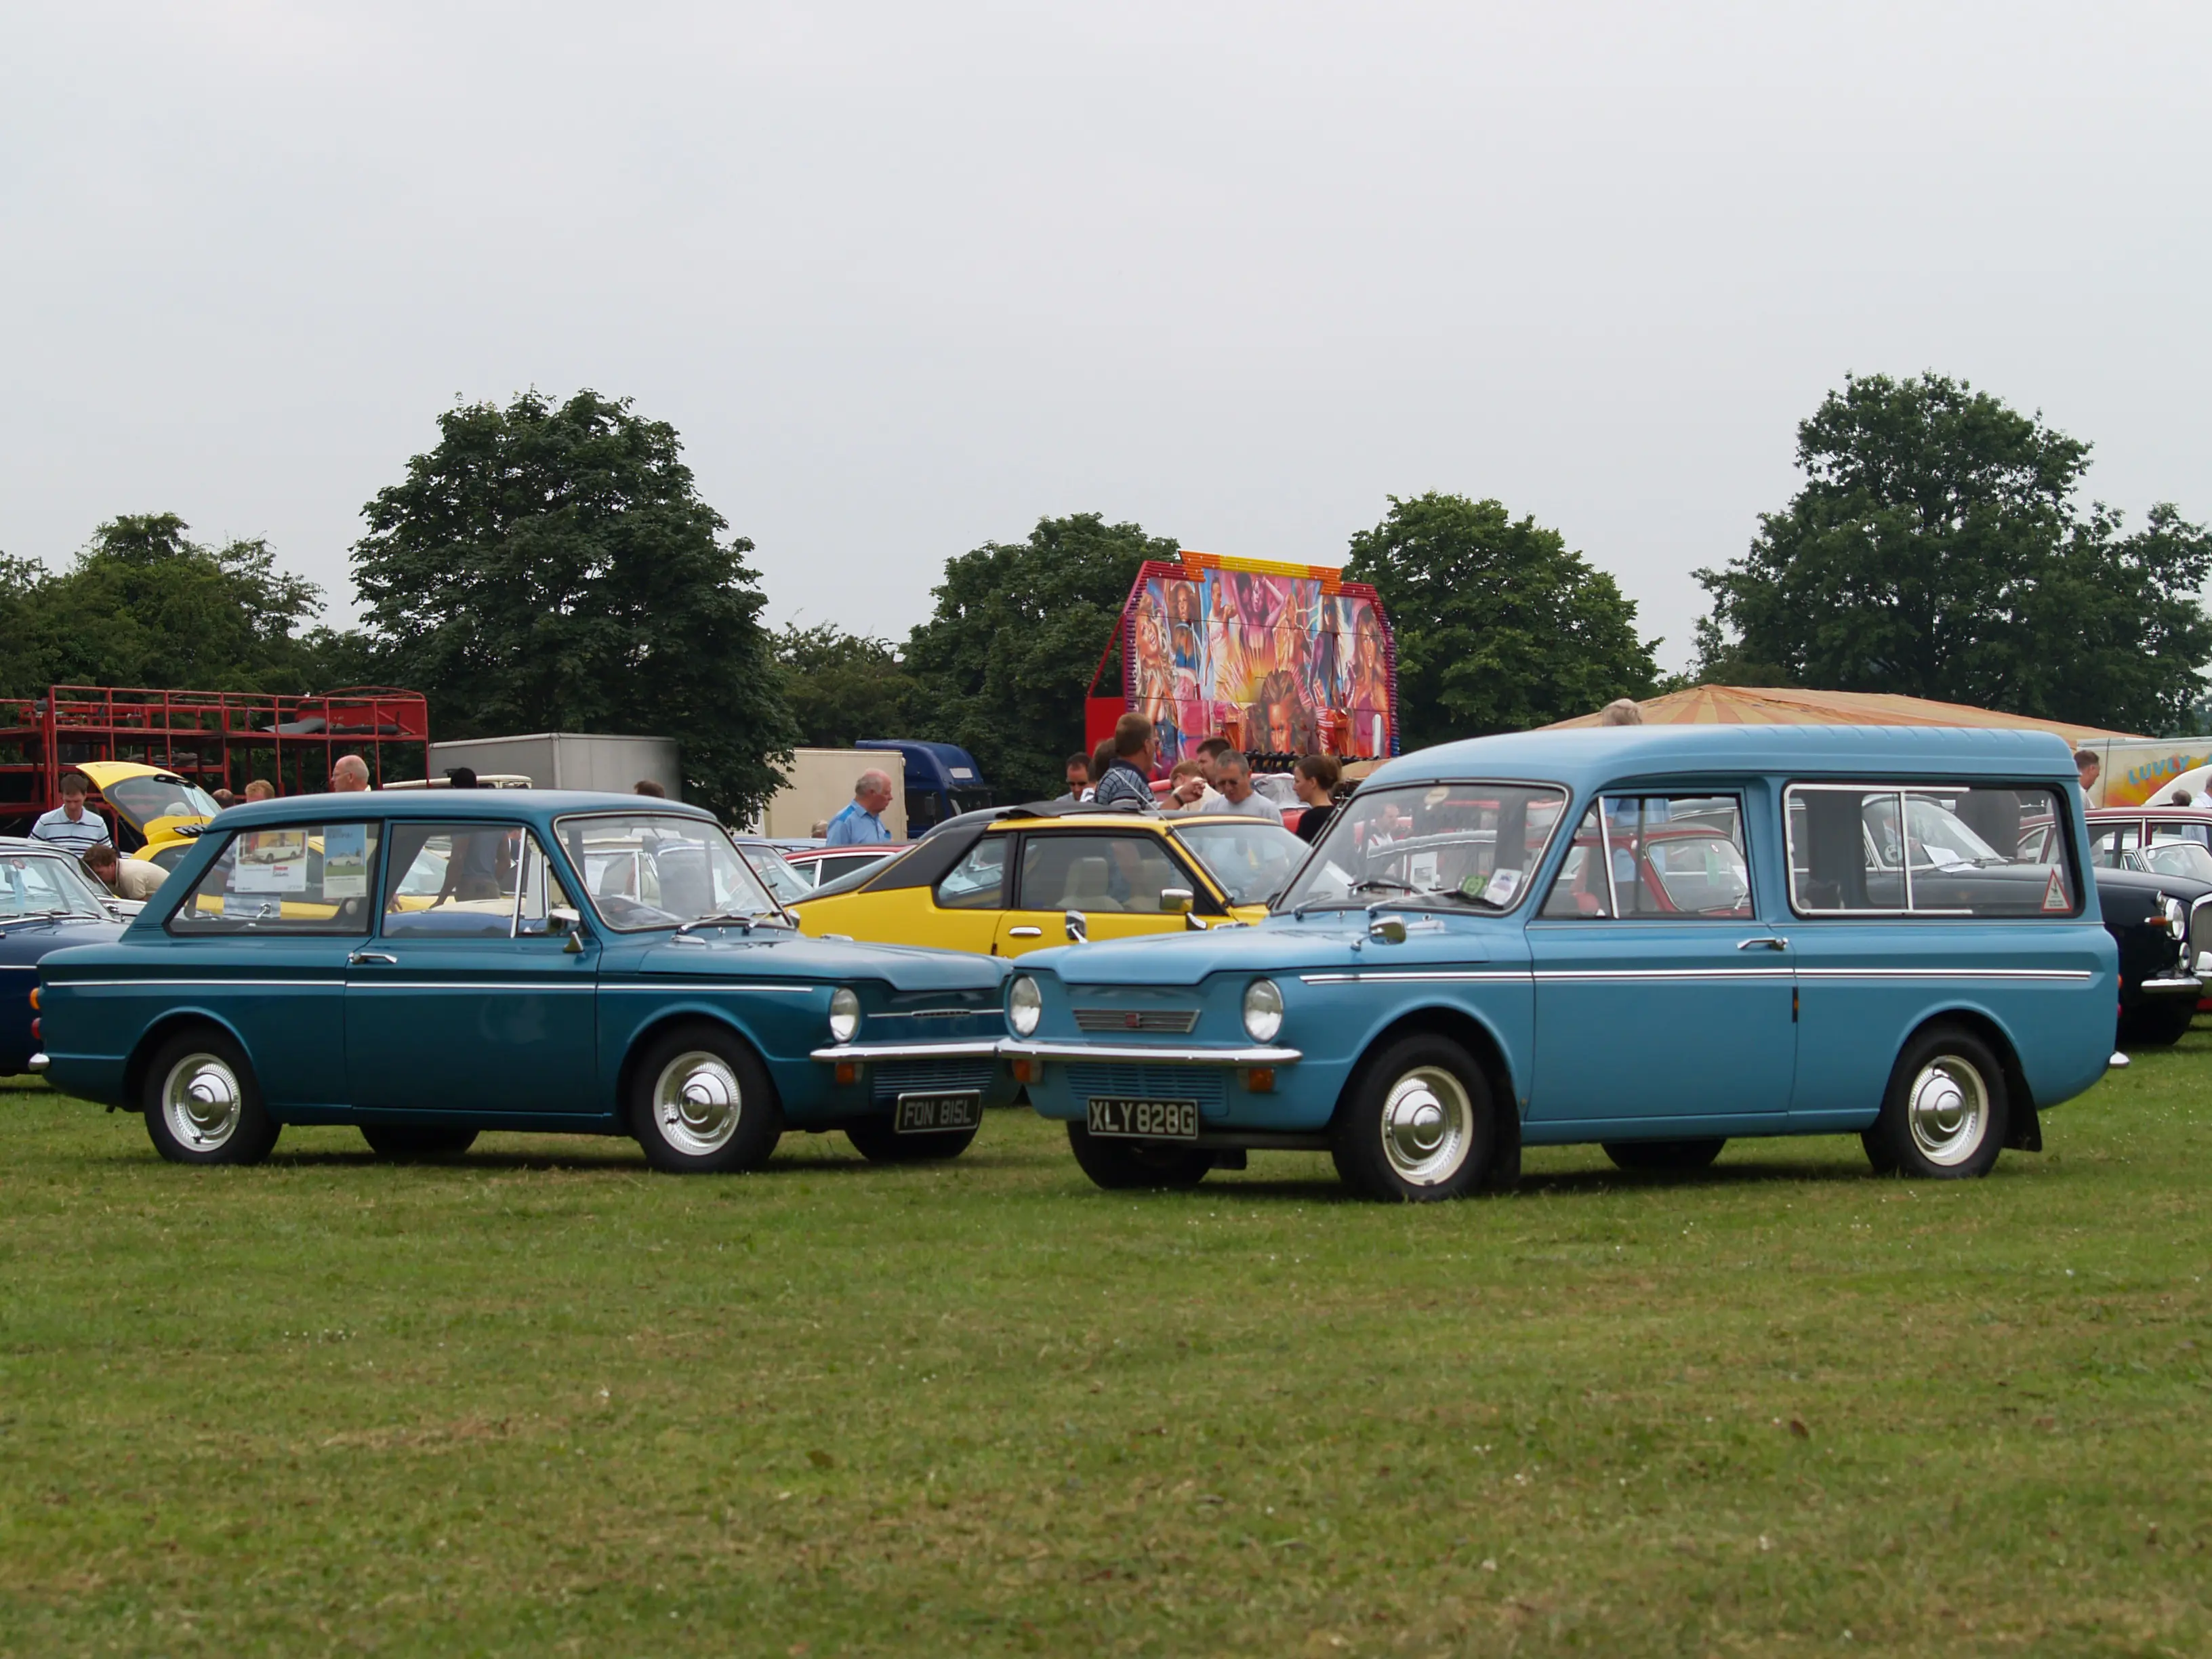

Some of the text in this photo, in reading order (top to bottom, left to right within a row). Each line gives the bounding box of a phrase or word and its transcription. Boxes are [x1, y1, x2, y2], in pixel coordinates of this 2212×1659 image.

[2128, 755, 2190, 785] LUVLY
[904, 1099, 971, 1126] FON 815L
